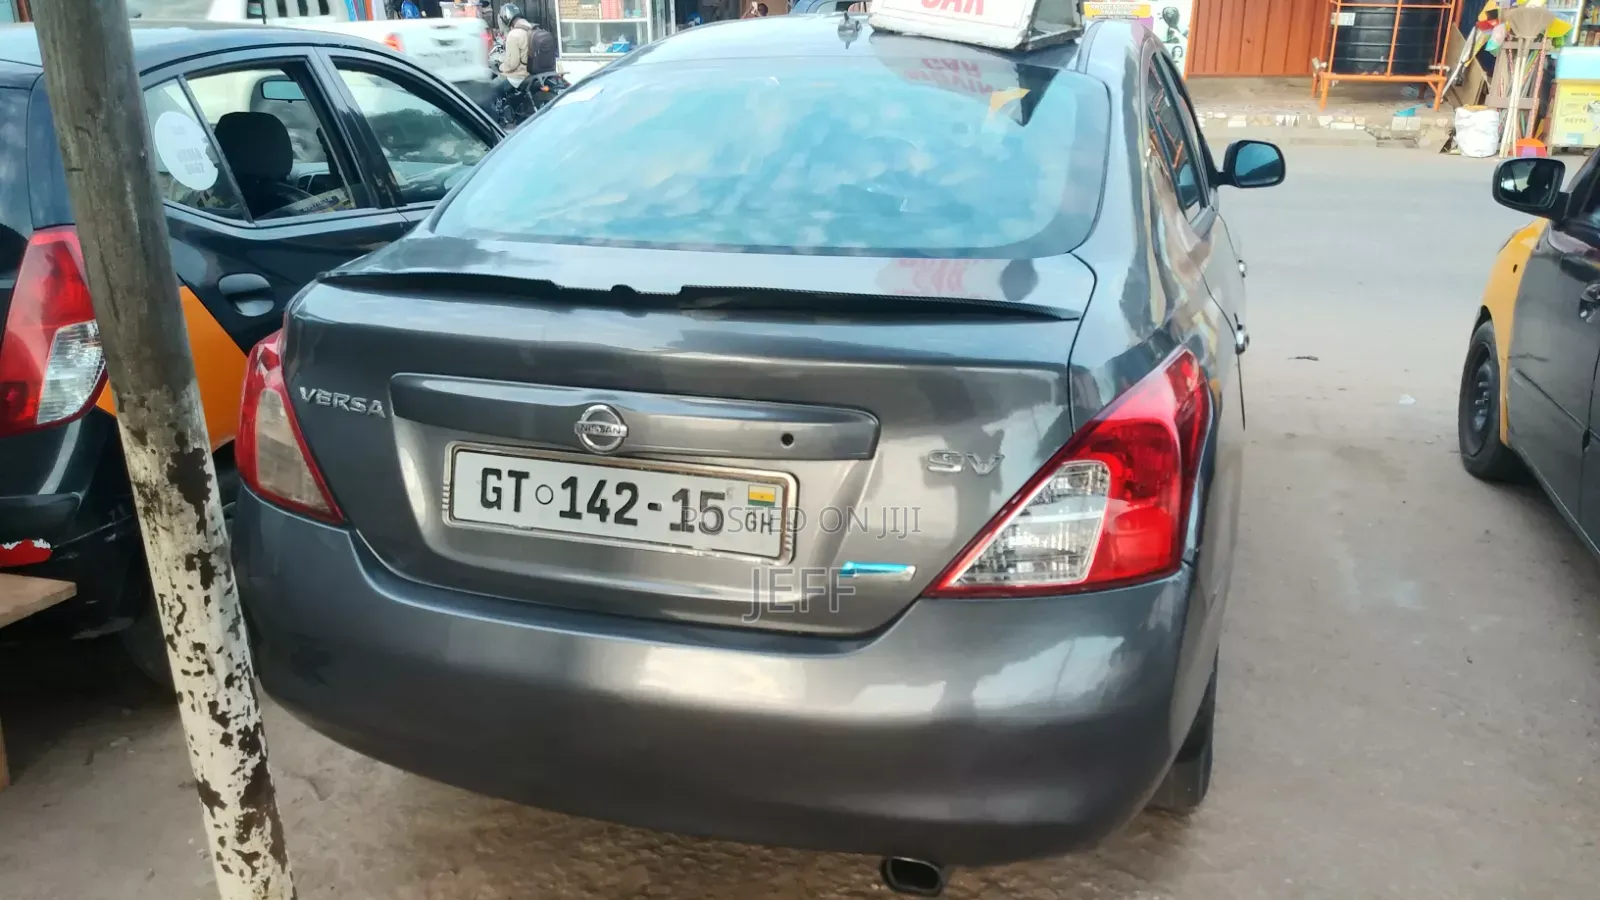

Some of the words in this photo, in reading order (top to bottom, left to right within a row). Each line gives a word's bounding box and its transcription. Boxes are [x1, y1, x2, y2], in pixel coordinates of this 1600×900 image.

[299, 386, 386, 419] VERSA
[580, 423, 621, 435] NISSAN
[927, 450, 1005, 476] SV
[479, 467, 530, 513] GT
[559, 475, 727, 536] 142-15
[744, 510, 774, 536] GH
